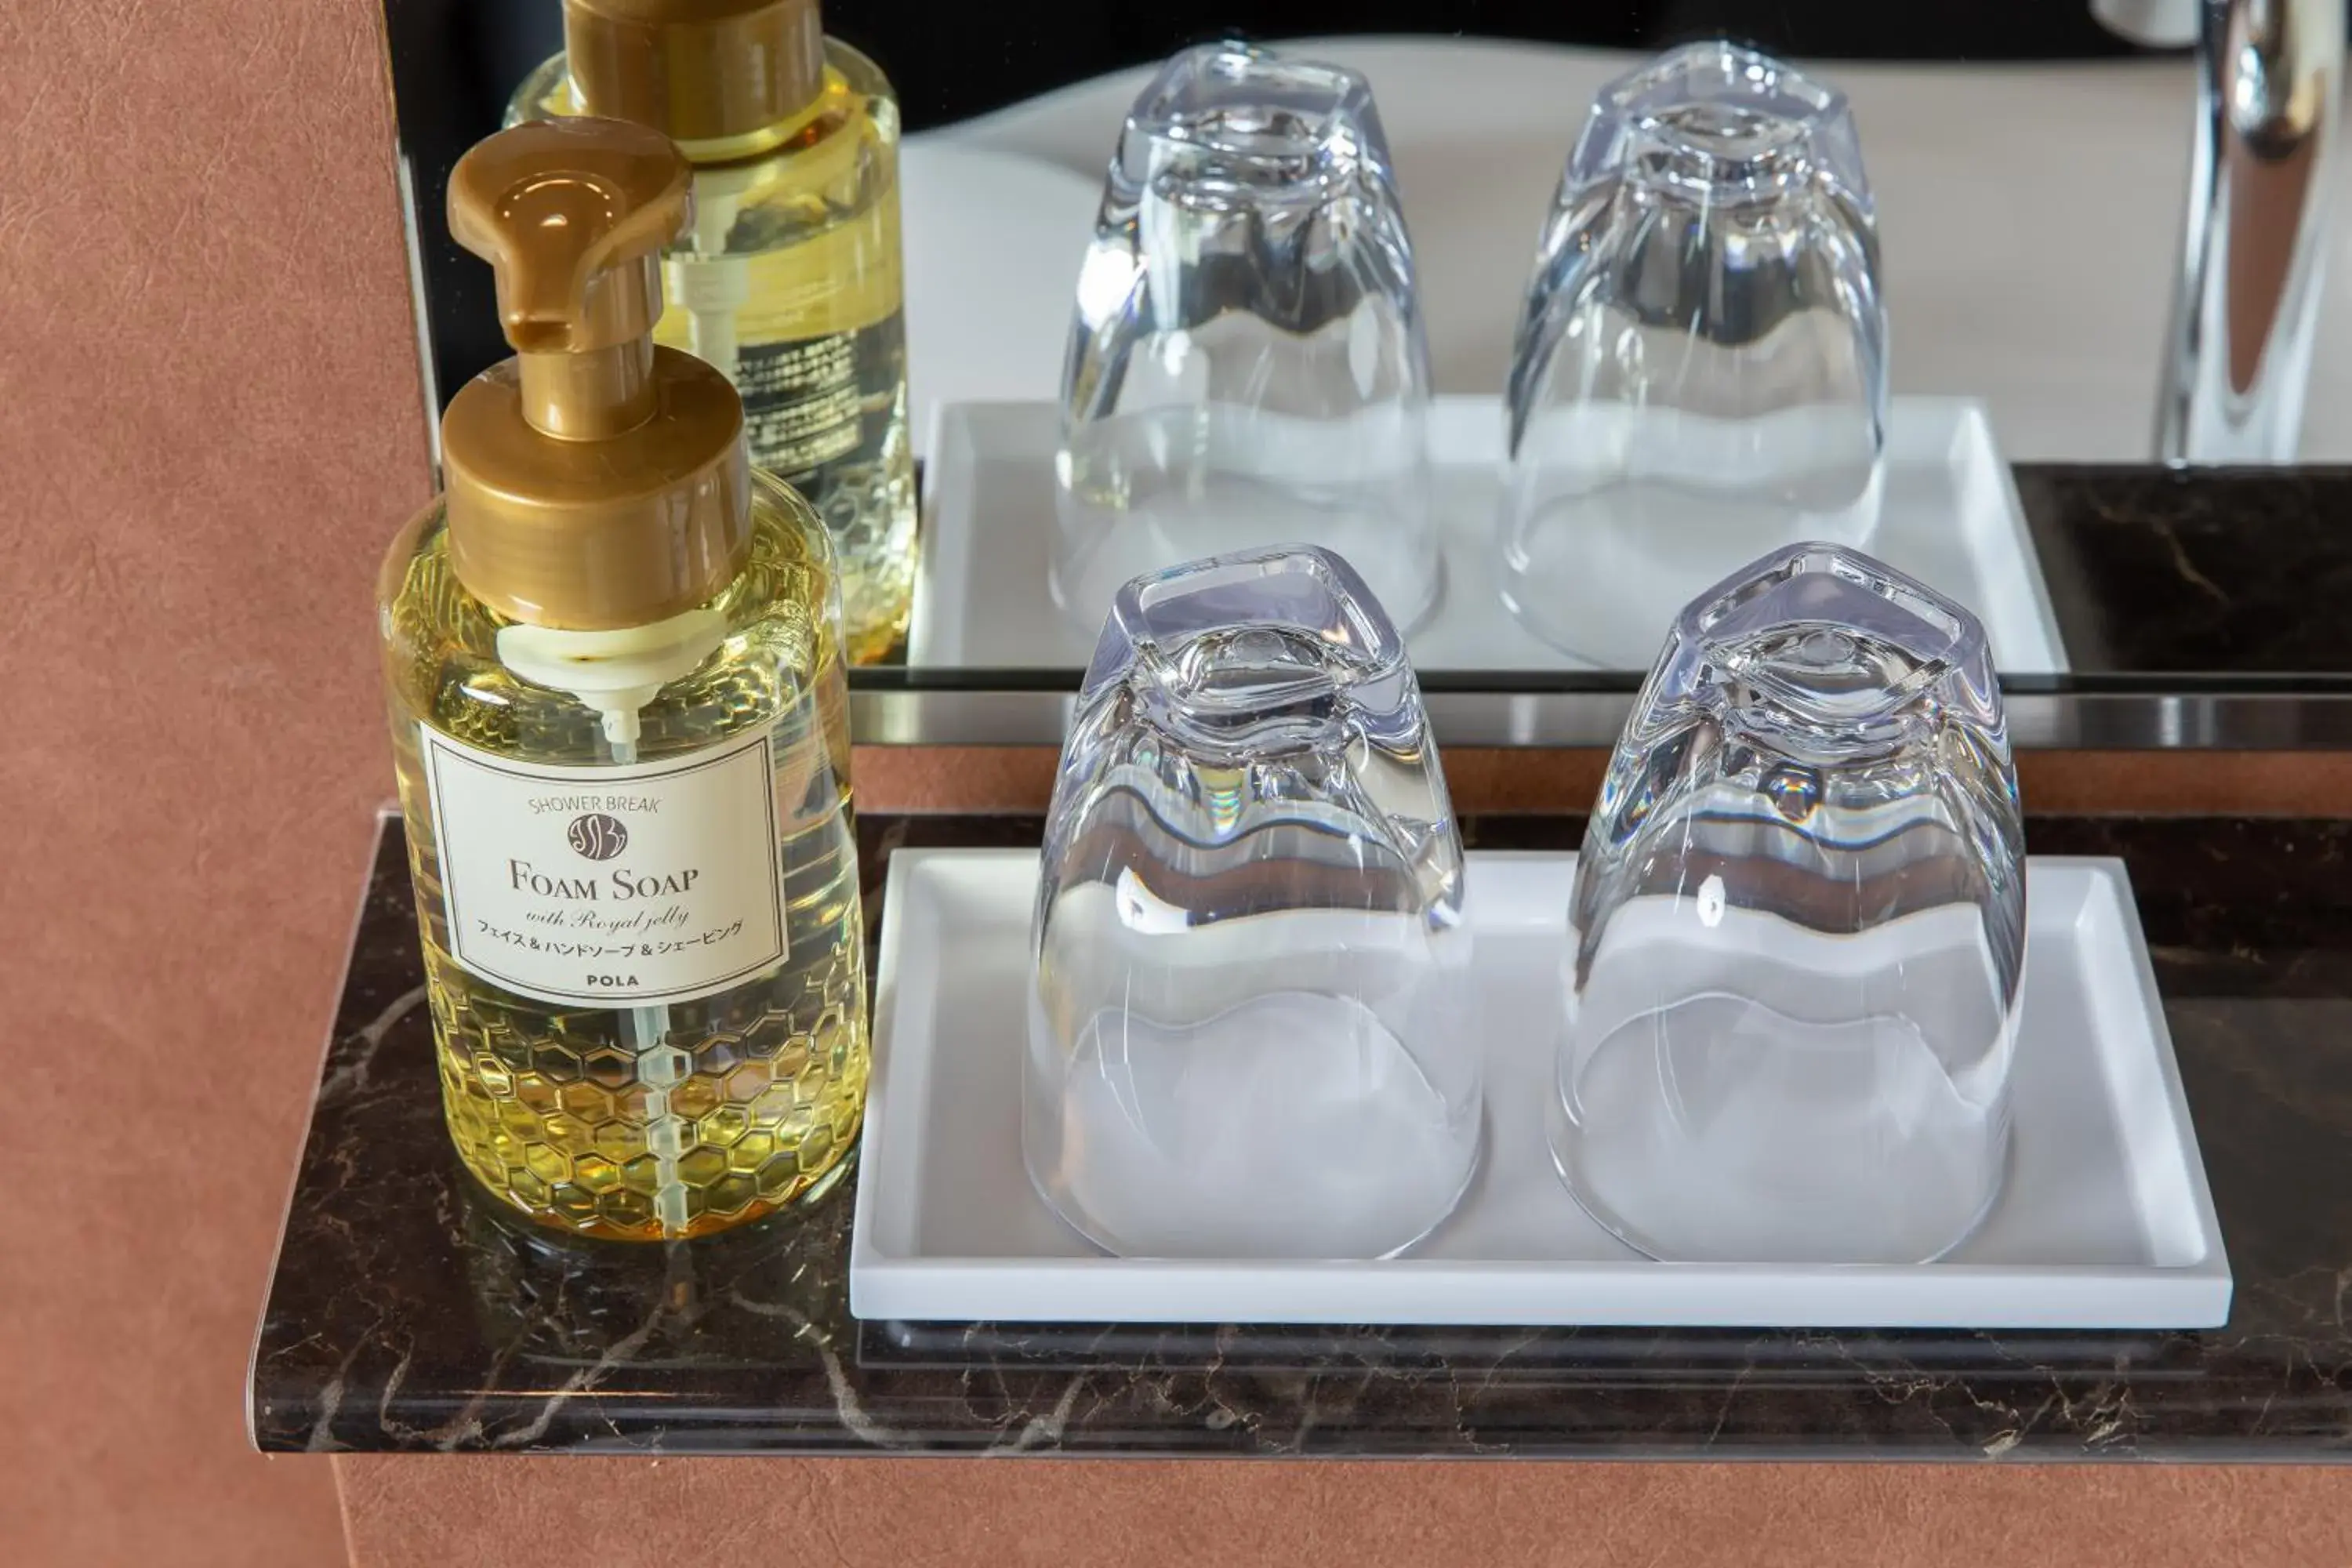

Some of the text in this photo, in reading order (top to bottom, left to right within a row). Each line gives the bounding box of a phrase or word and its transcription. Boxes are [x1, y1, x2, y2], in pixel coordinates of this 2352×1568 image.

[528, 795, 661, 815] SHOWER BREAK
[509, 858, 699, 901] FOAM SOAP
[525, 905, 690, 936] with Royal jelly
[586, 975, 640, 987] POLA
